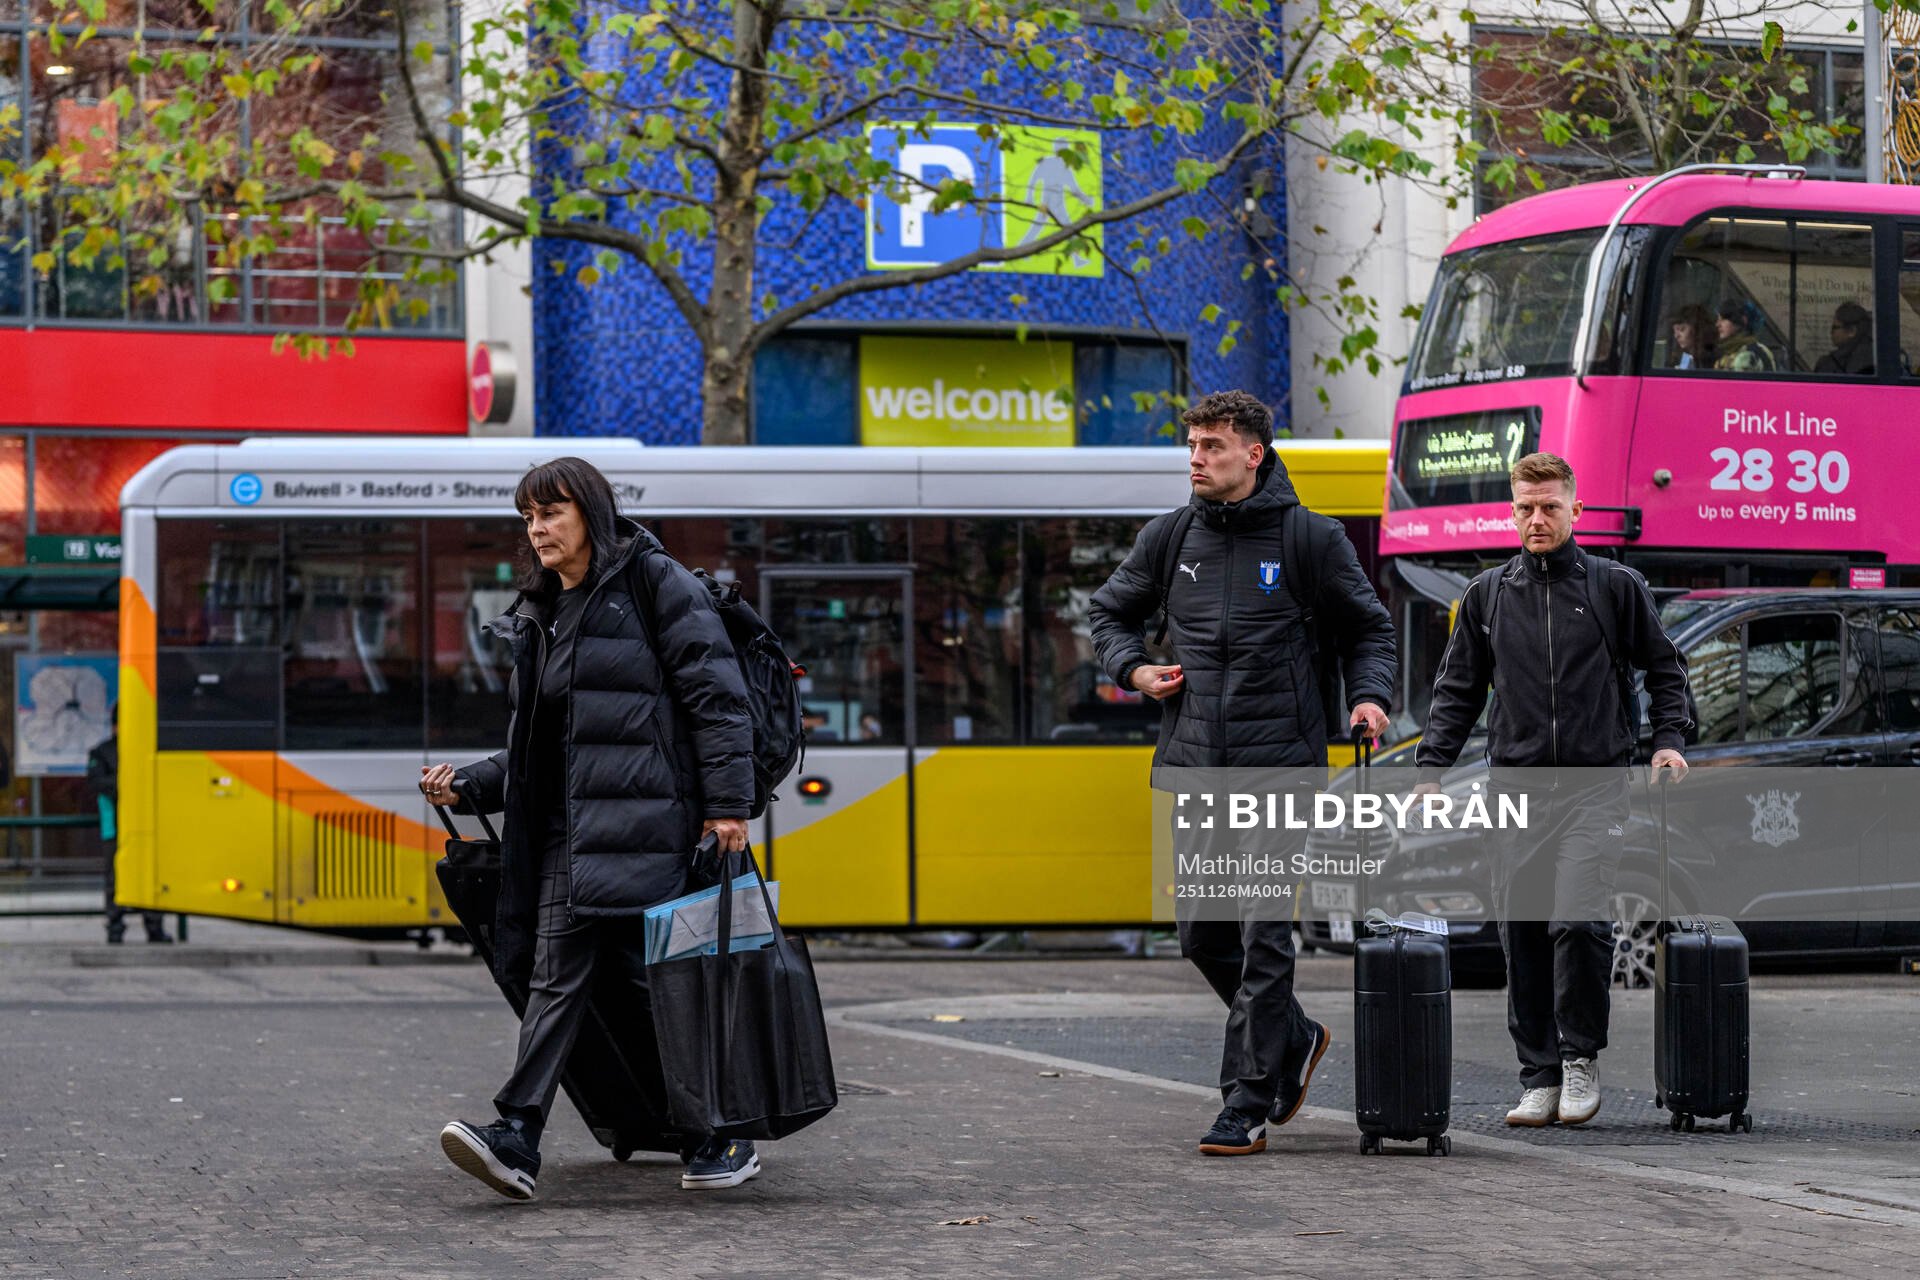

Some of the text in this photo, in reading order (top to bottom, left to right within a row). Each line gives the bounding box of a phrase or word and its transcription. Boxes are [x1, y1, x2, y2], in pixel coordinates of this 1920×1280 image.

[901, 143, 976, 248] P
[866, 378, 1069, 422] welcome
[1724, 408, 1837, 437] Pink Line
[1710, 447, 1850, 494] 28 30
[273, 481, 341, 498] Bulwell
[362, 481, 432, 498] Basford
[1698, 502, 1857, 524] Up to every 5 mins
[1413, 522, 1429, 536] mins
[1443, 519, 1457, 537] Pay
[1458, 518, 1475, 533] with
